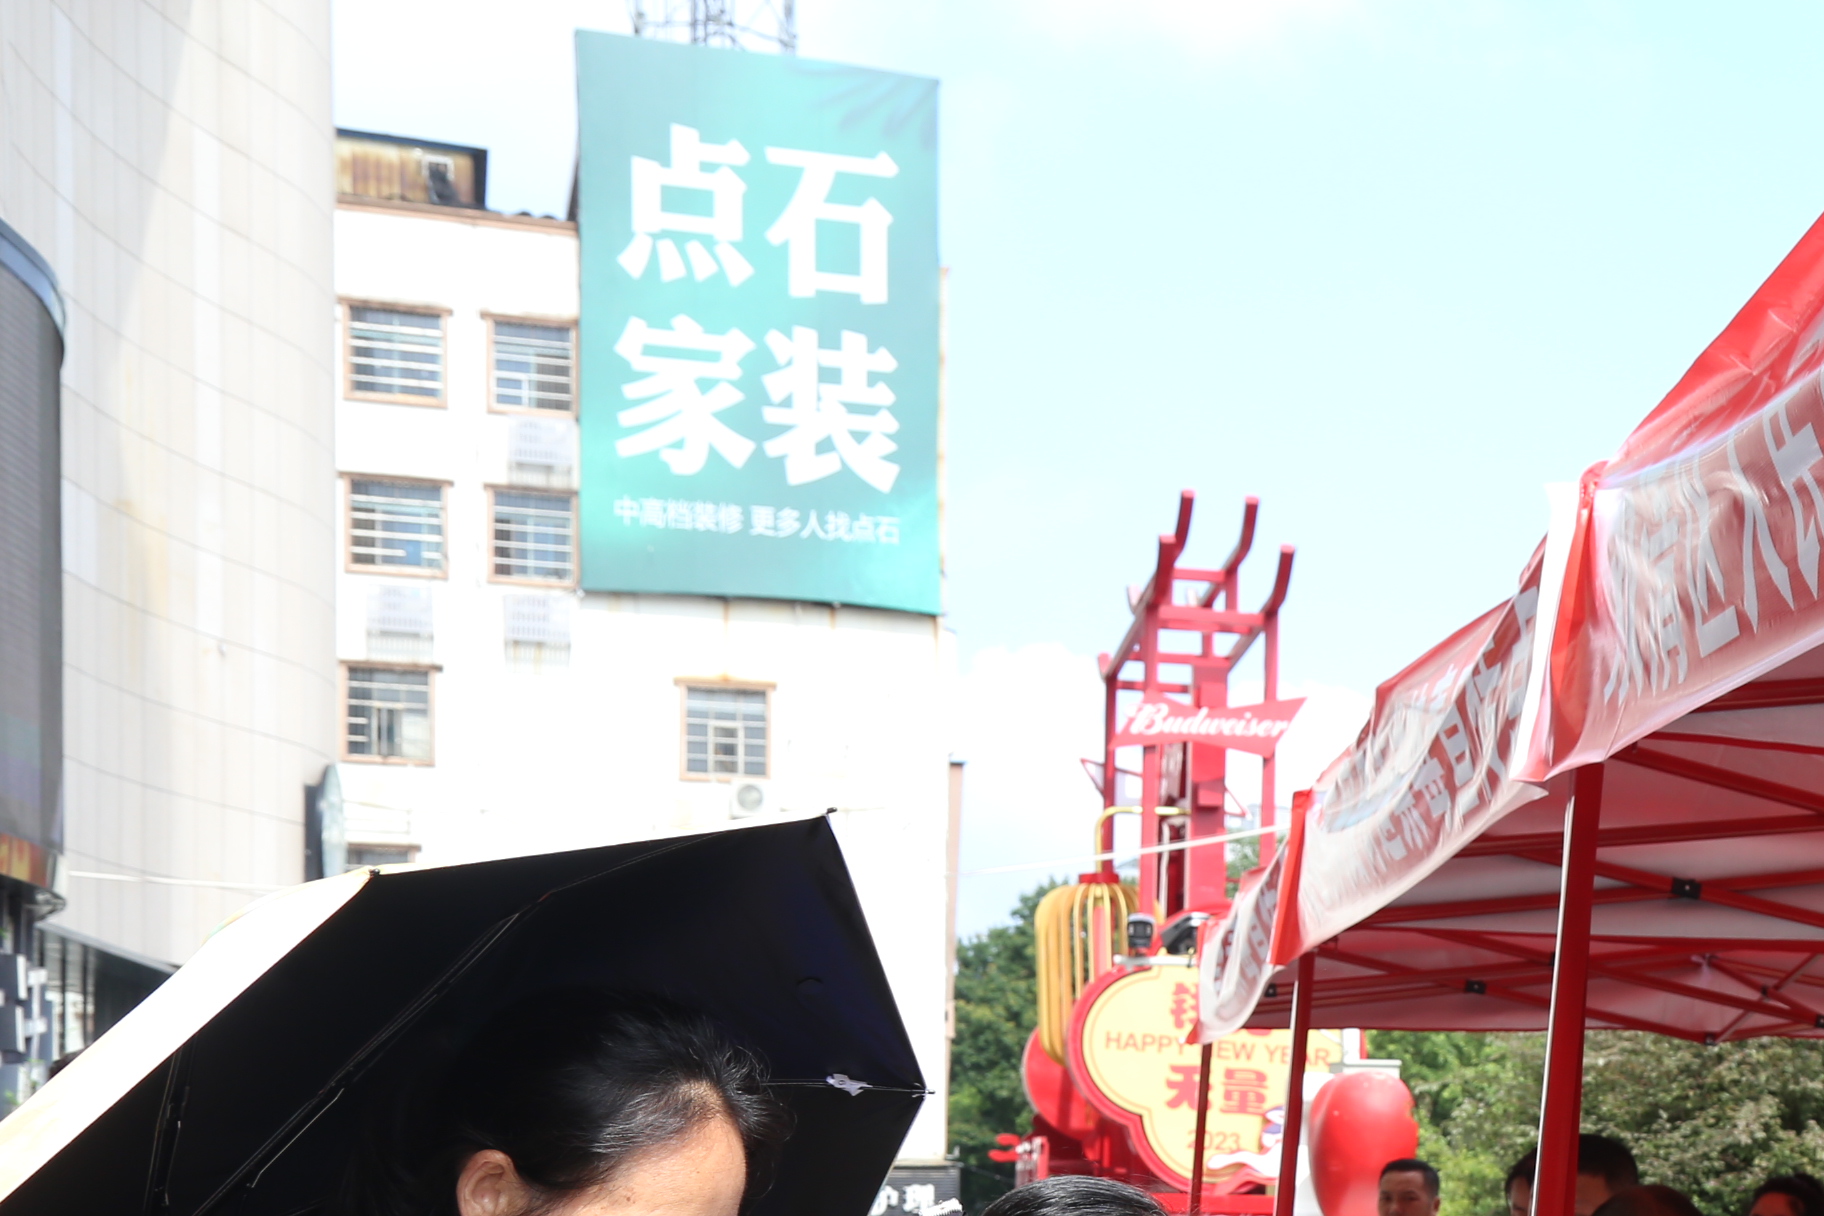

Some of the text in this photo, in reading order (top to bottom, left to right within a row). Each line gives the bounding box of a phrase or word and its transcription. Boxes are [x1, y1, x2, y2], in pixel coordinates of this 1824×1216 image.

[616, 122, 899, 304] 点石
[613, 313, 901, 494] 家装
[613, 494, 900, 544] 中高档装修 更多人找点石
[1125, 703, 1290, 737] Budweiser
[1209, 1038, 1256, 1062] EW
